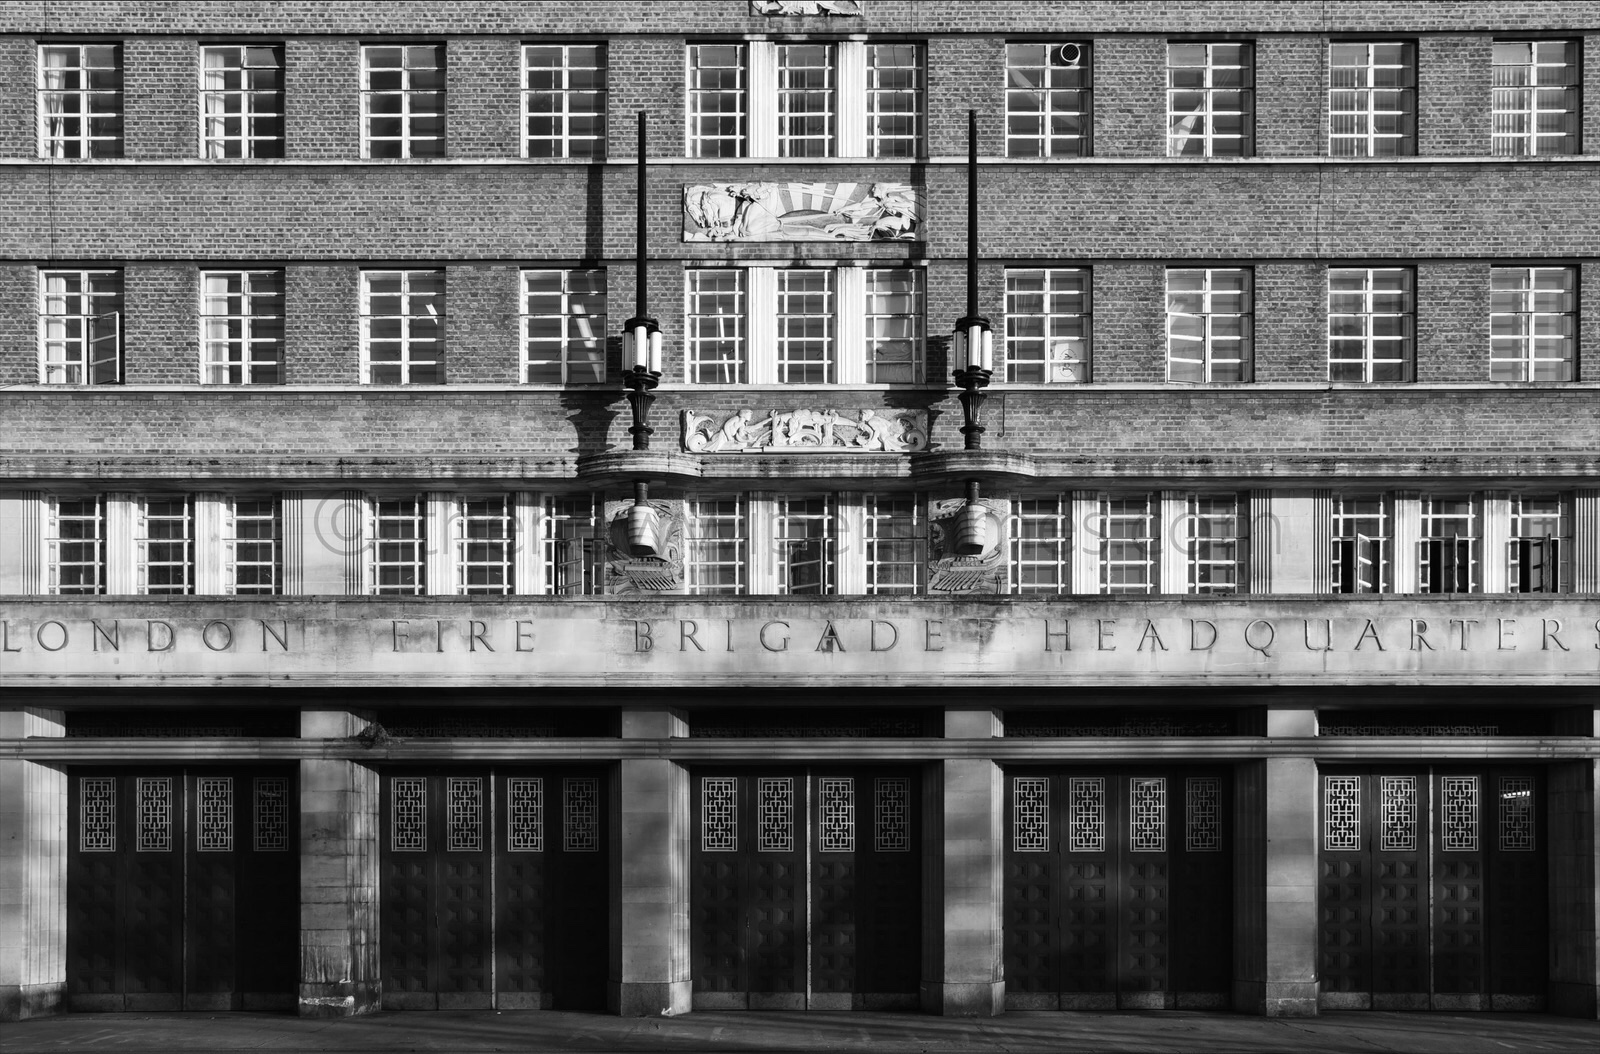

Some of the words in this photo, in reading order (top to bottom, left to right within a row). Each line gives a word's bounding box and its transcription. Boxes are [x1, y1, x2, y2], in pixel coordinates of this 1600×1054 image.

[2, 619, 289, 653] LONDON
[392, 619, 535, 653] FIRE
[634, 618, 945, 653] BRIGADE
[1043, 618, 1600, 657] HEADQUARTER
